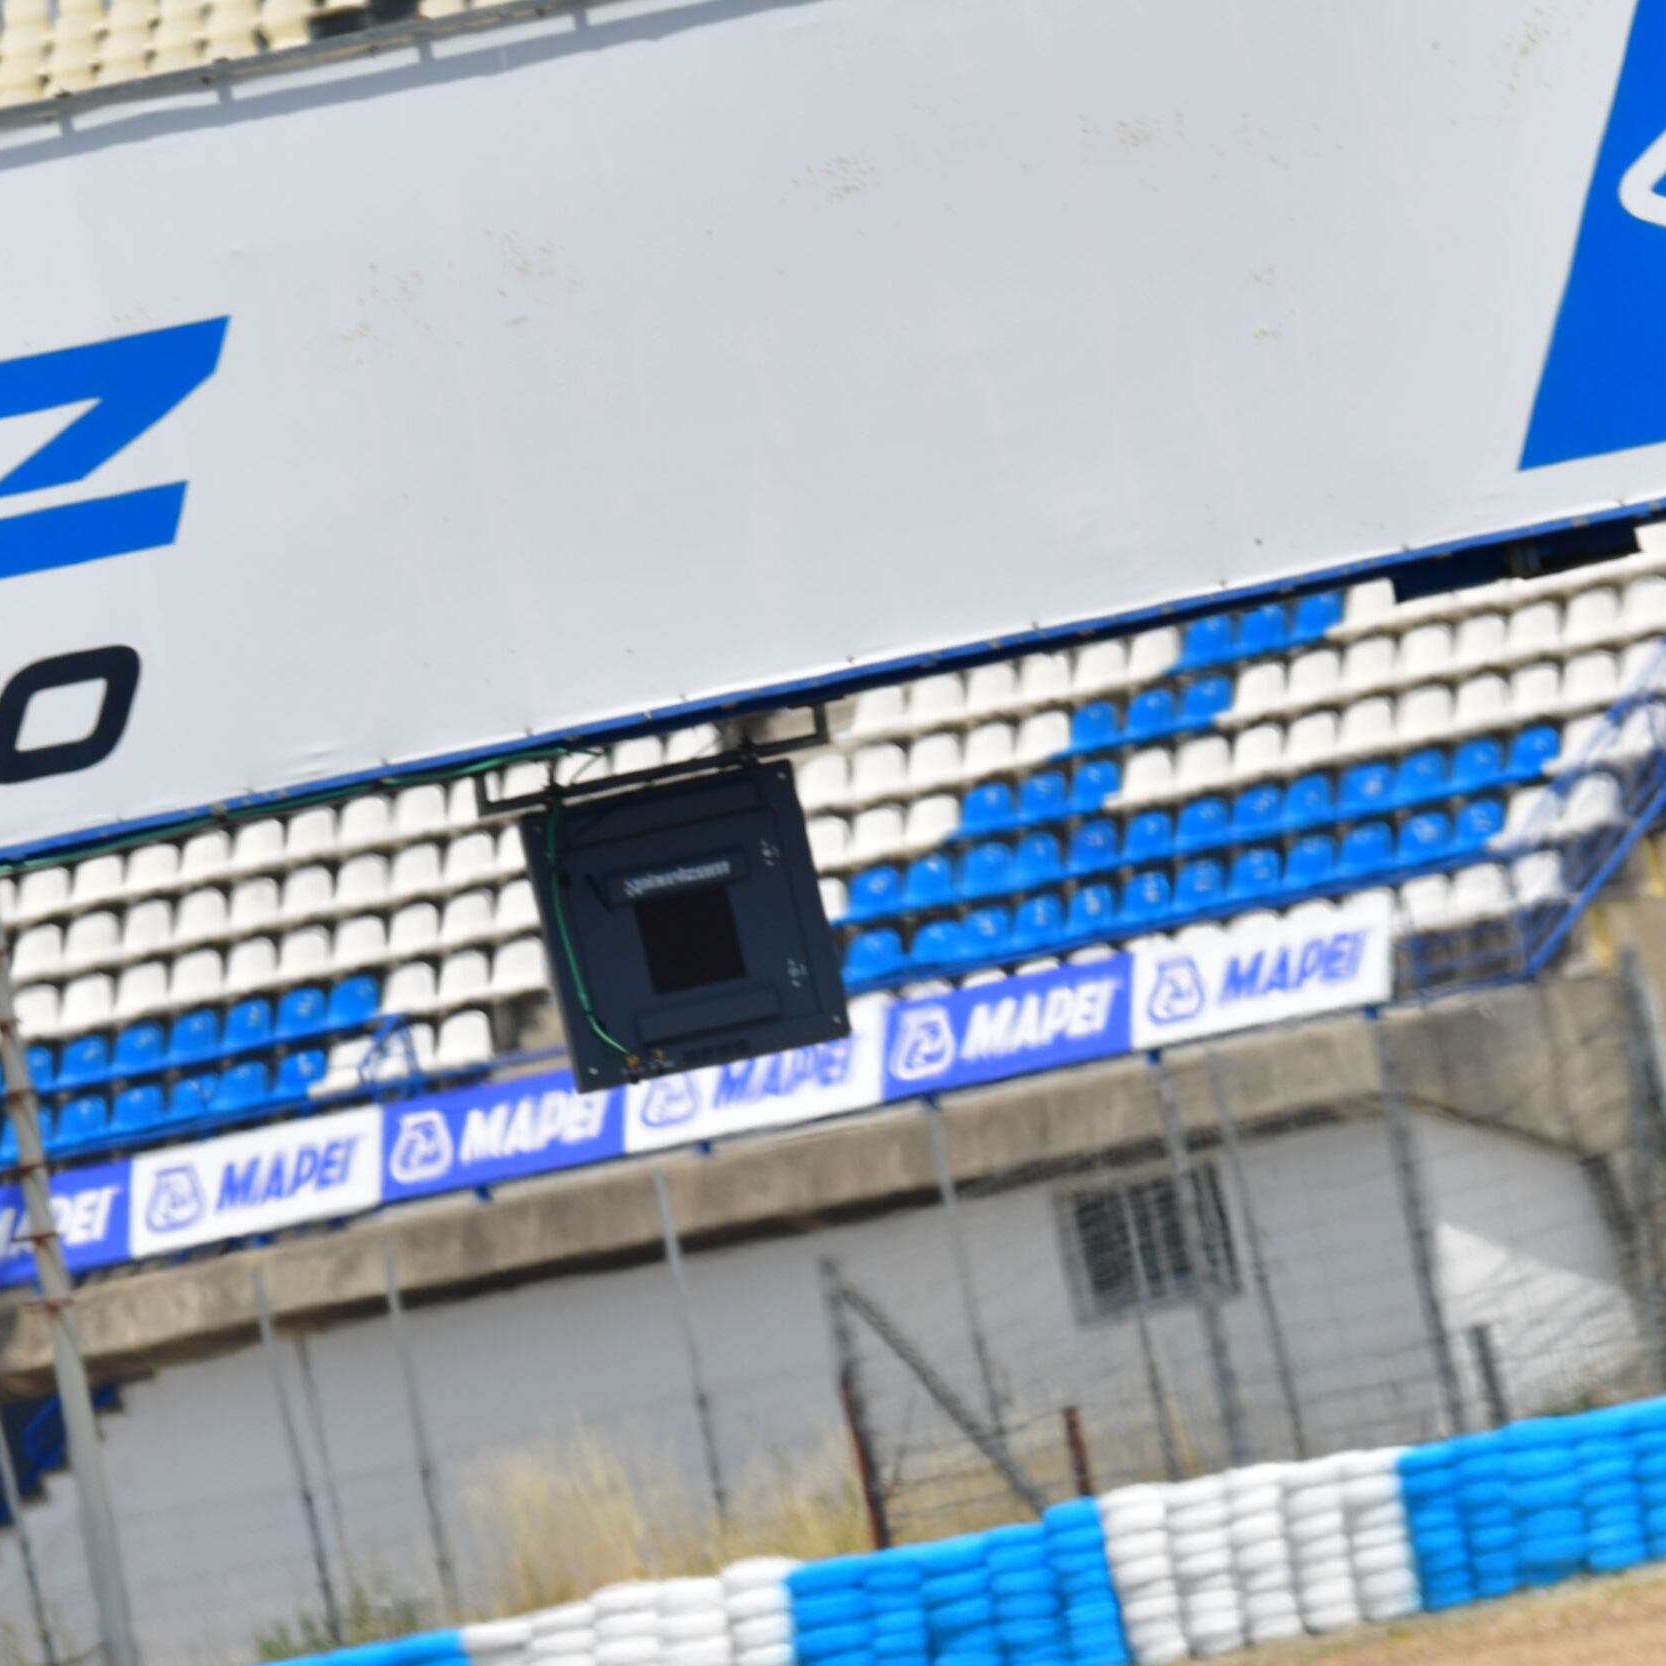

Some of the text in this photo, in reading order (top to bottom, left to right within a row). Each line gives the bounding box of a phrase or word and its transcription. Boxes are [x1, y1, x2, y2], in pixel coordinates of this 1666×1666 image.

[1217, 928, 1370, 1009] MAPEI
[961, 978, 1120, 1059] MAPEI
[460, 1089, 611, 1162] MAPEI
[216, 1134, 357, 1213] MAPEI
